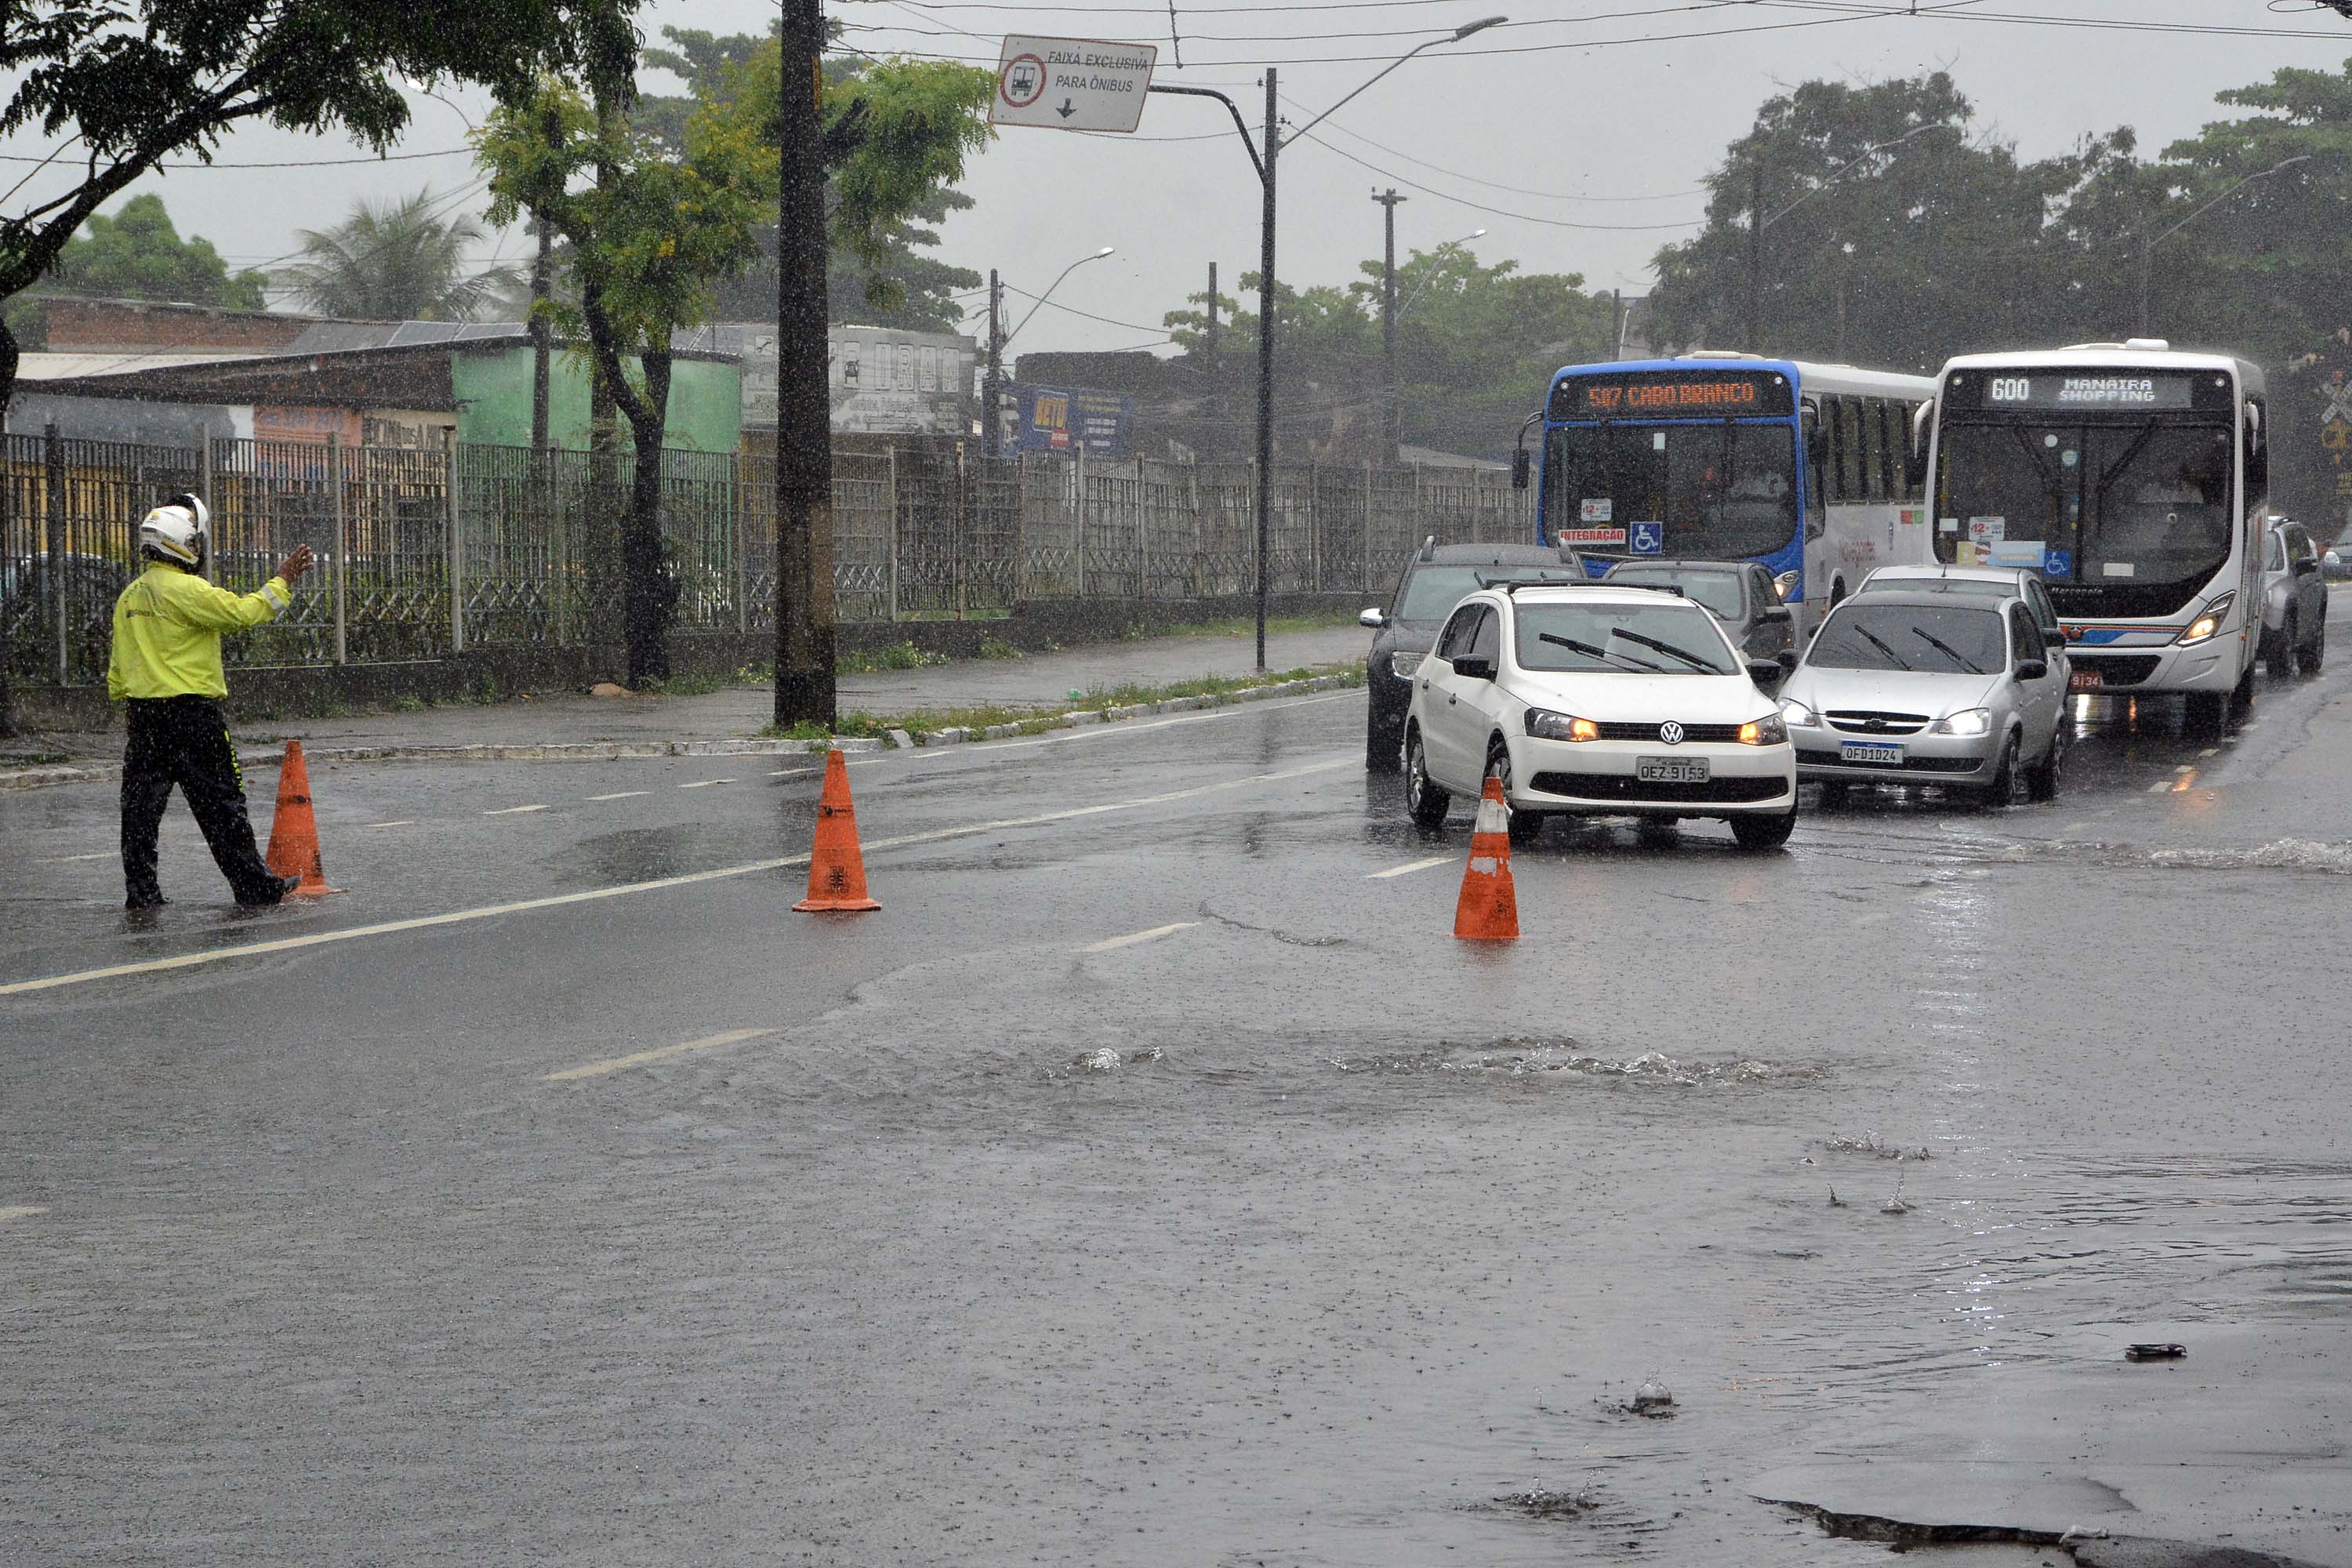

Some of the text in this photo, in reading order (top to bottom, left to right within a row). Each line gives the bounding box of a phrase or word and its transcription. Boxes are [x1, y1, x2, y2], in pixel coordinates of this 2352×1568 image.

[1047, 51, 1148, 71] FAIXA EXCLUSIVA
[1055, 74, 1134, 93] PARA ÔNIBUS
[1628, 385, 1677, 406] CABO
[1679, 382, 1755, 405] BRANCO
[1992, 379, 2152, 400] 600 MANAIRA
[2059, 390, 2155, 401] SHOPPING
[1560, 528, 1624, 542] INTEGRAÇÃO
